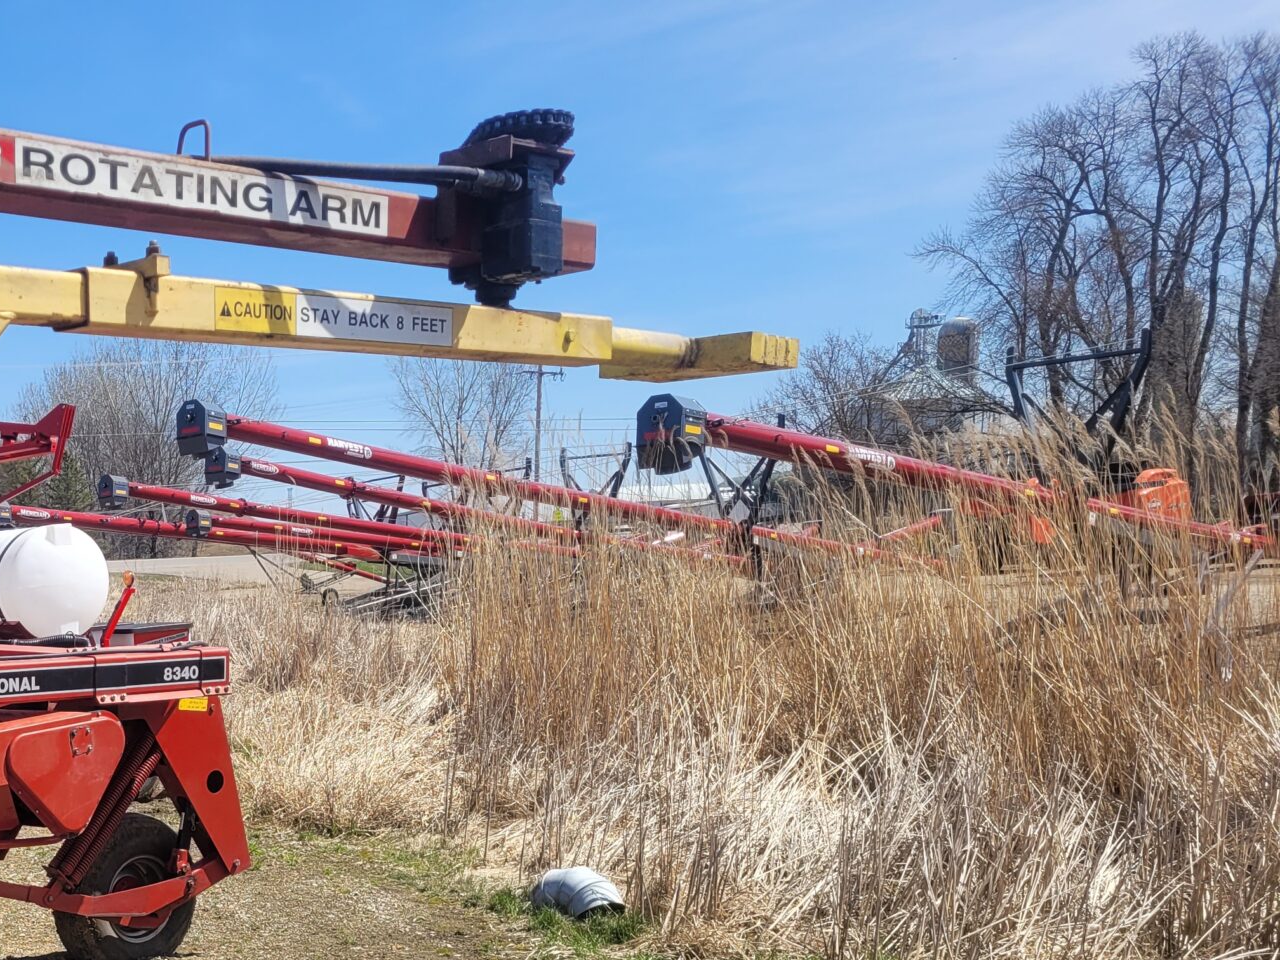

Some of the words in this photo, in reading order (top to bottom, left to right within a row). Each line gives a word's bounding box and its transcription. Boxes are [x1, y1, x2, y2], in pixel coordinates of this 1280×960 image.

[22, 145, 273, 214] ROTATING
[289, 189, 381, 229] ARM
[234, 301, 292, 321] CAUTION
[300, 307, 340, 325] STAY
[349, 311, 389, 330] BACK
[396, 314, 404, 331] 8
[412, 316, 447, 334] FEET
[163, 665, 199, 681] 8340
